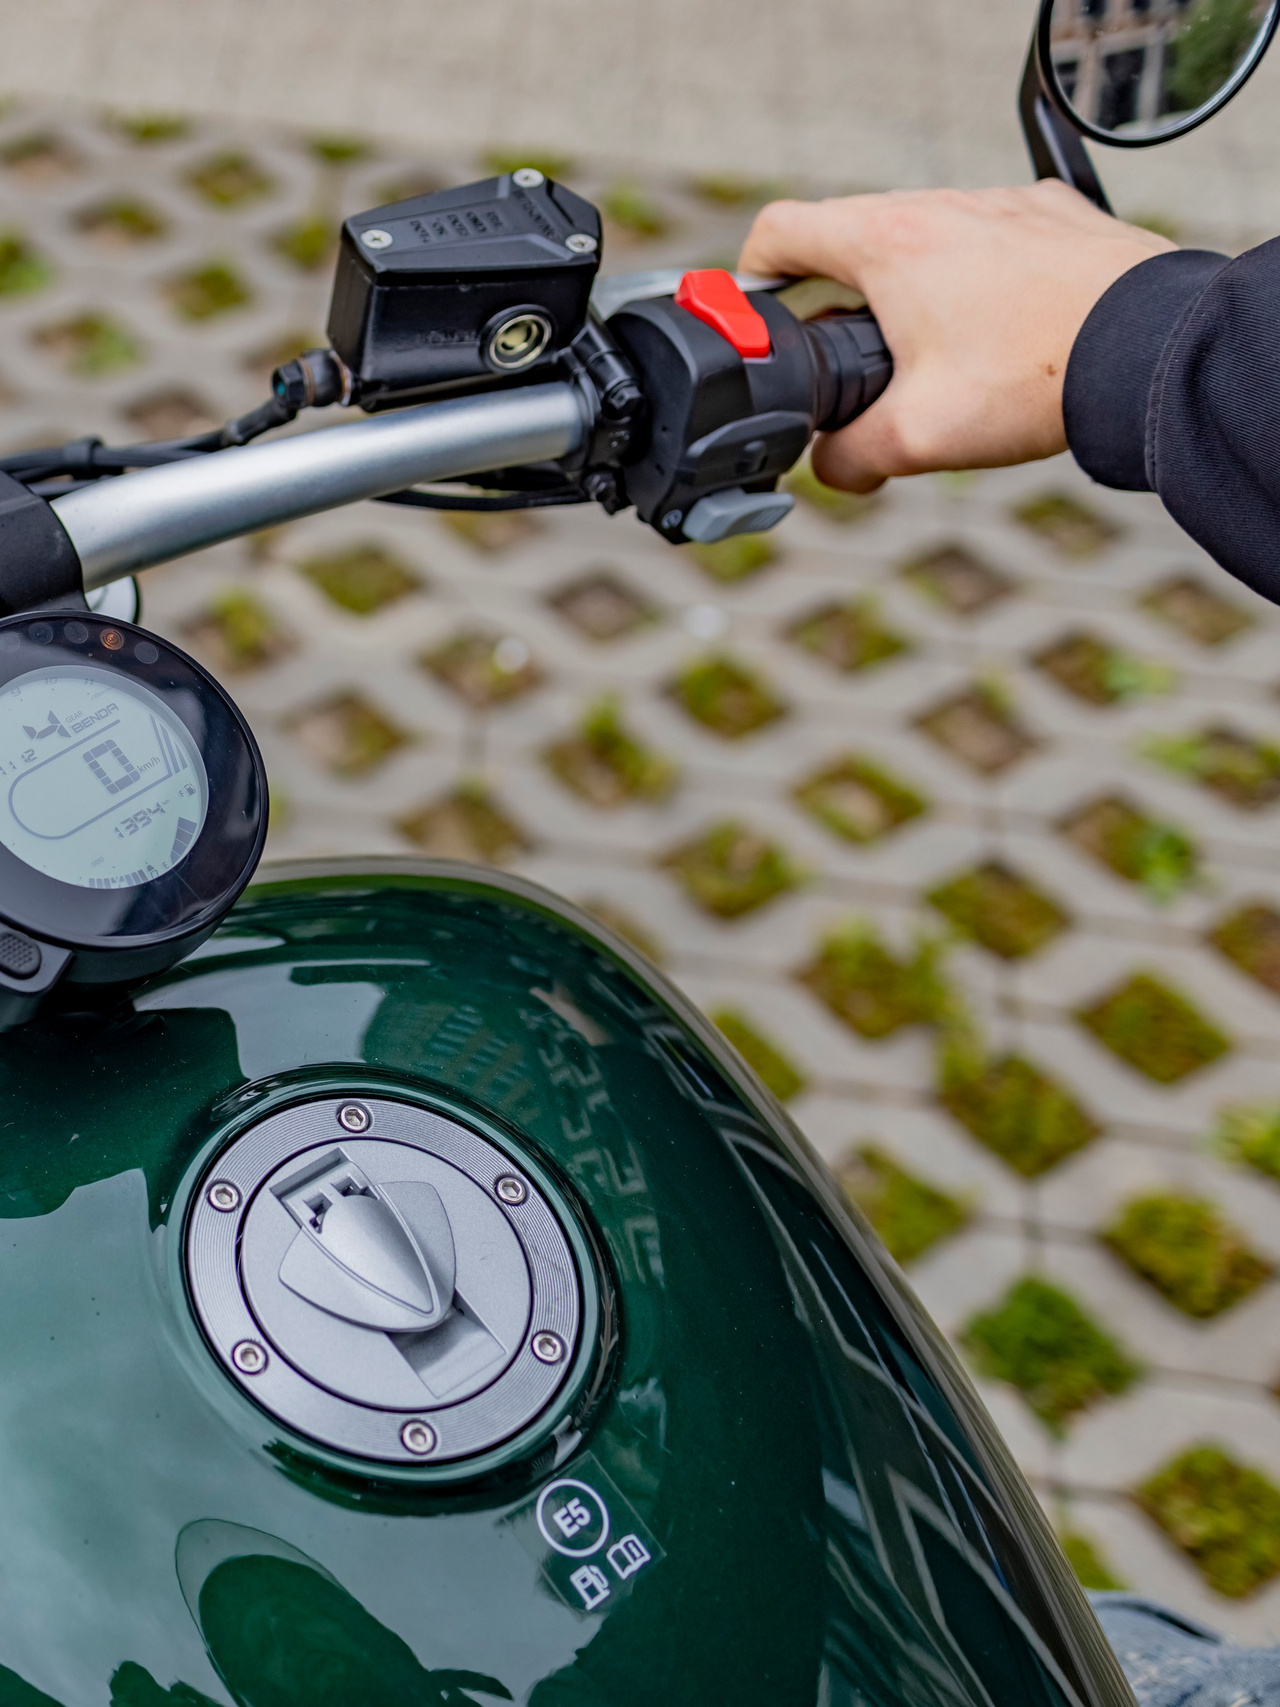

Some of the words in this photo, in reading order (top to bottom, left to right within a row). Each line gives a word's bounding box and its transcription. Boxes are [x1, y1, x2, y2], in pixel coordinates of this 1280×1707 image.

[22, 710, 72, 740] 4
[65, 710, 84, 724] GEAR
[70, 703, 120, 734] BENDA
[82, 739, 141, 794] 0
[136, 756, 161, 773] km/h
[178, 790, 185, 798] F
[114, 801, 167, 838] 1394
[162, 861, 170, 870] E
[552, 1496, 592, 1539] E5
